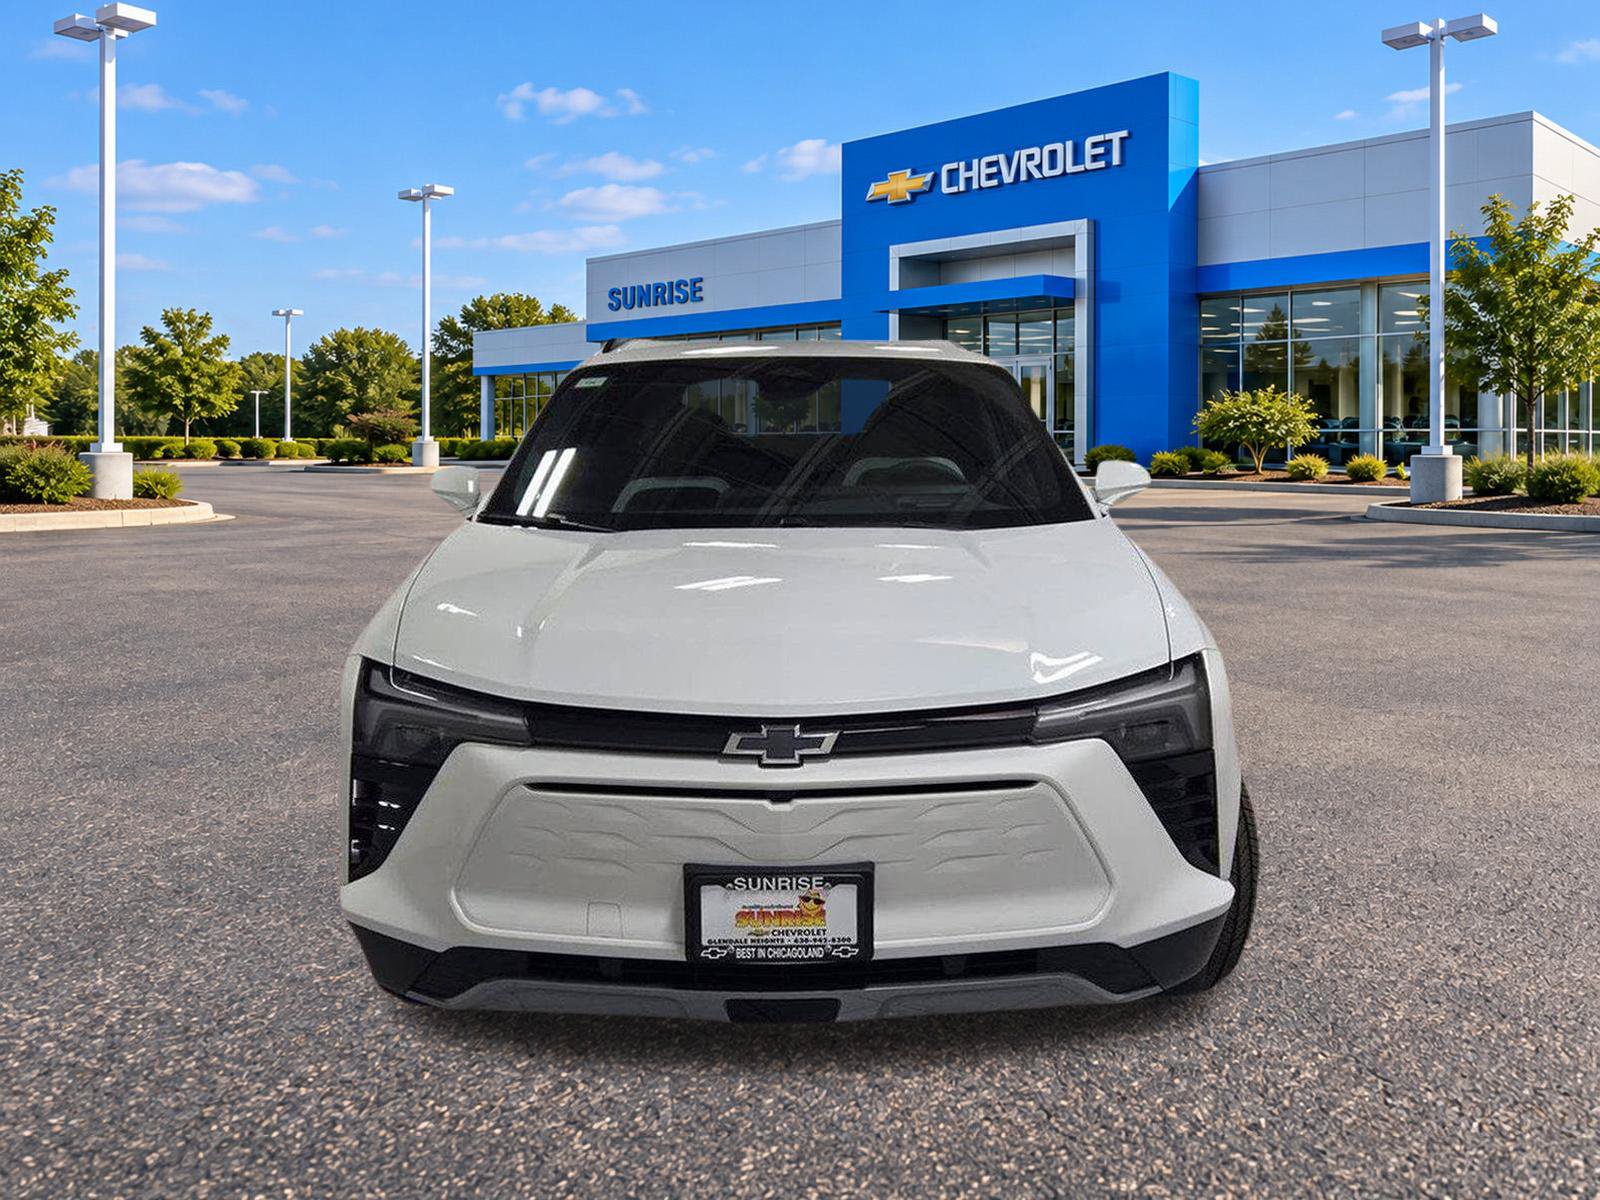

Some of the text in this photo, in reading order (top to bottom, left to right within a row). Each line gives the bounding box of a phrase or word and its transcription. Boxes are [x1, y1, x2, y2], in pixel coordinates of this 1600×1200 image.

[941, 130, 1128, 194] CHEVROLET
[608, 277, 704, 311] SUNRISE
[734, 876, 824, 890] SUNRISE
[771, 928, 827, 937] CHEVROLET
[736, 947, 824, 959] BEST IN CHICAGOLAND
